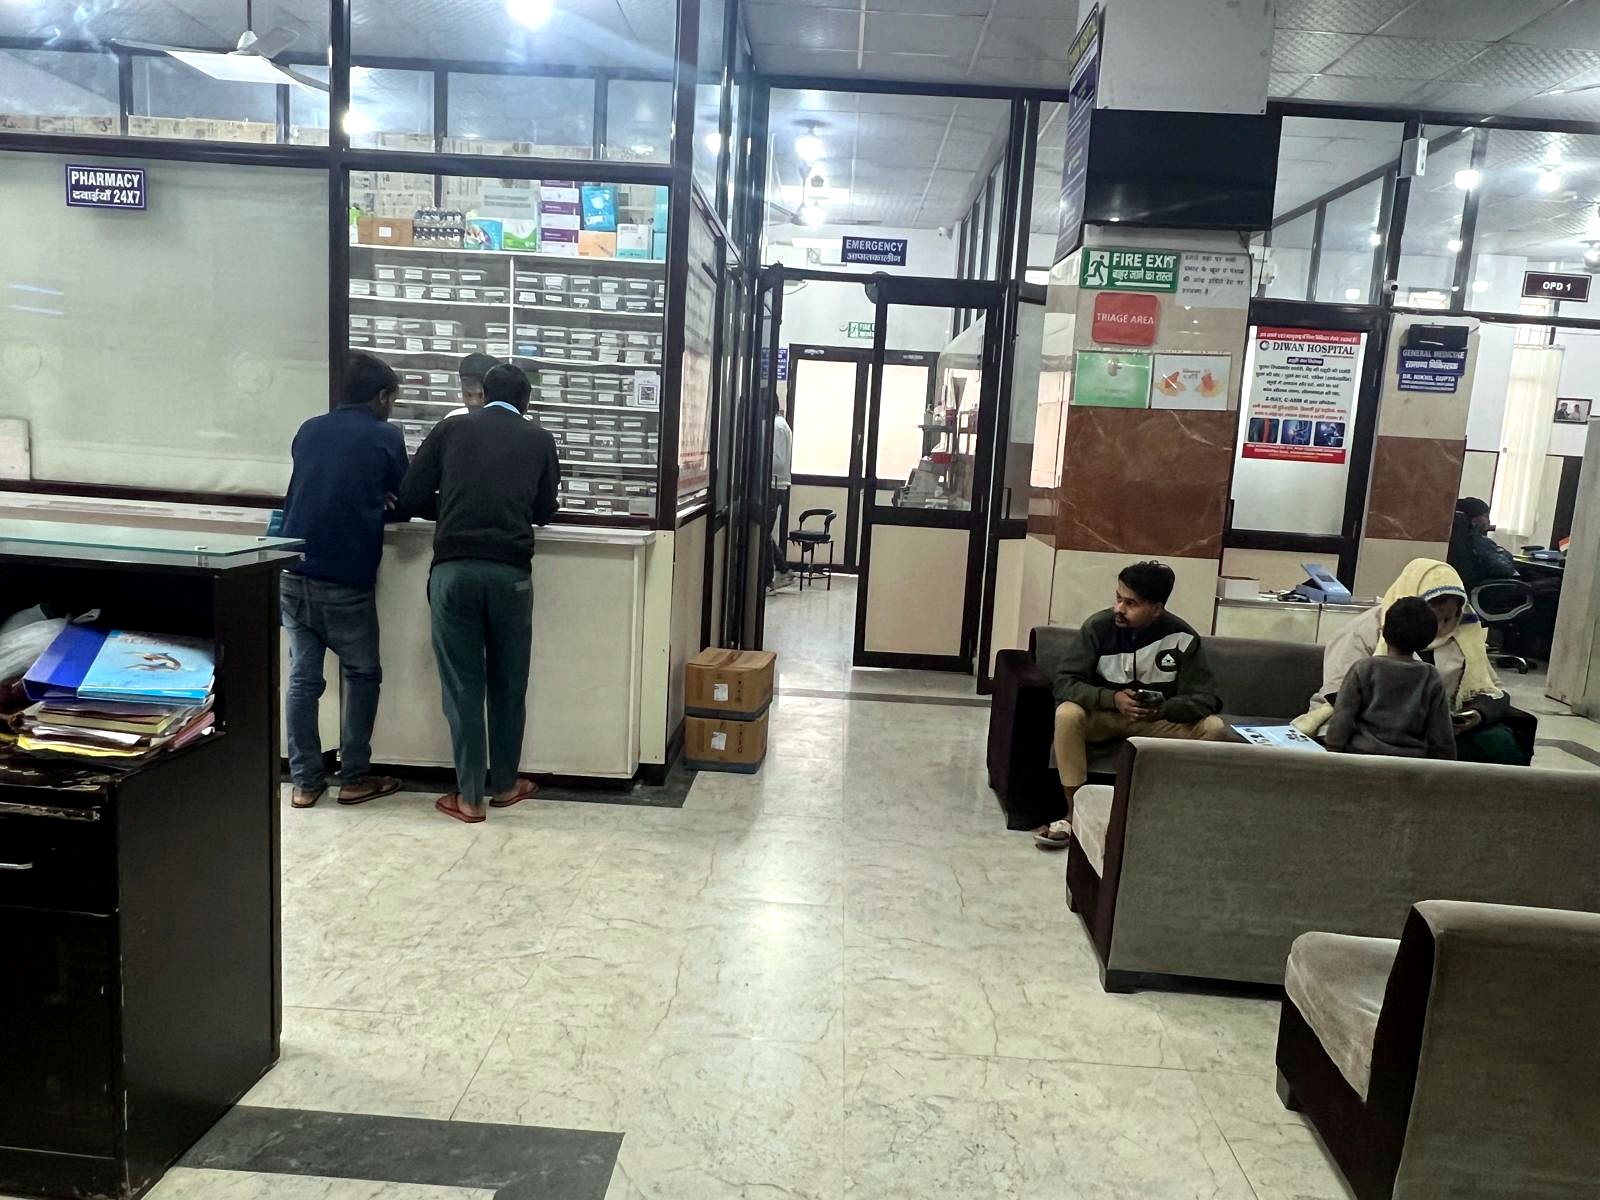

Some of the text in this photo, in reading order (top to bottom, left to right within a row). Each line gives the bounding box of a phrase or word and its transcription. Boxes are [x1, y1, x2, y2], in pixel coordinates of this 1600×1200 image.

[71, 171, 140, 188] PHARMACY
[72, 188, 141, 204] दवाईयाँ 24X7
[846, 239, 904, 252] EMERGENCY
[846, 252, 902, 263] आपातकालीन
[1112, 252, 1177, 269] FIRE EXIT
[1145, 270, 1155, 281] का
[1542, 281, 1572, 291] OPD 1
[1096, 312, 1154, 325] TRIAGE AREA
[1272, 341, 1355, 356] DIWAN HOSPITAL
[1402, 349, 1465, 359] GENERAL MEDICINE
